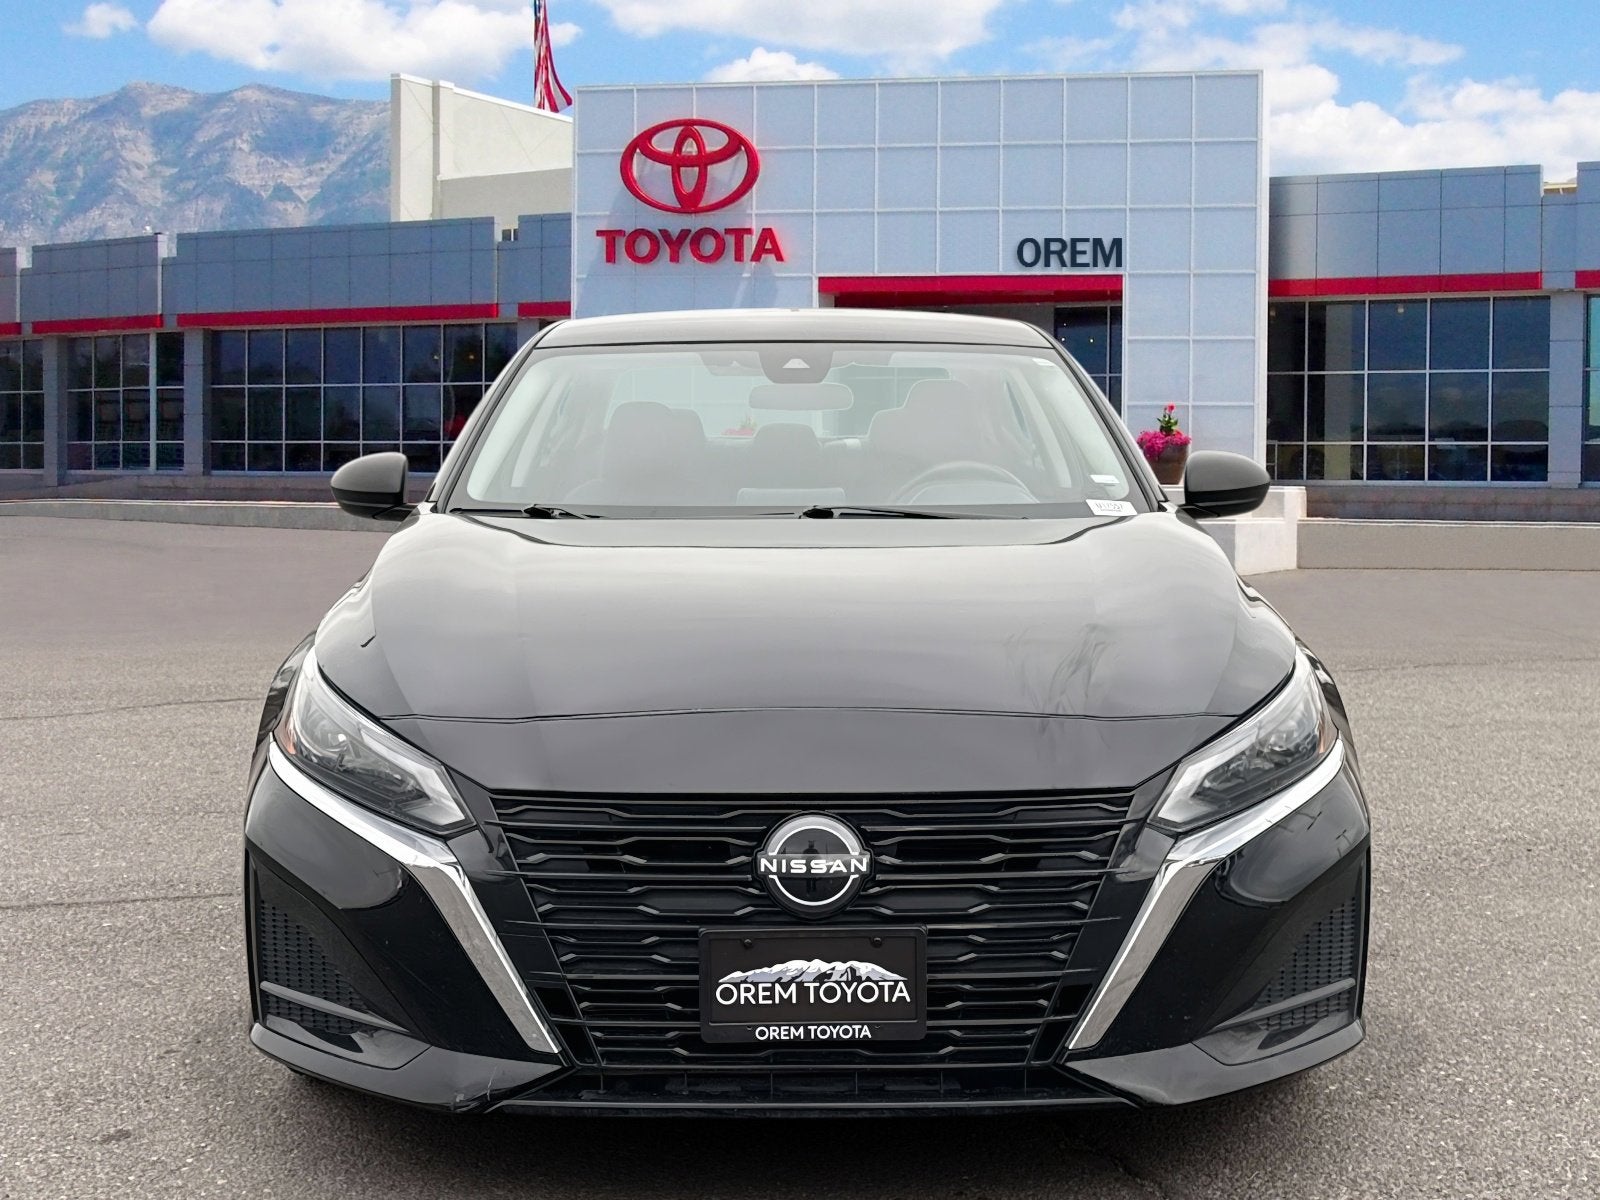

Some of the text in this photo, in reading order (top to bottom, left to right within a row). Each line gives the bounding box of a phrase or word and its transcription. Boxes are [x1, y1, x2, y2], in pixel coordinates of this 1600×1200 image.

[596, 227, 785, 264] TOYOTA
[1017, 237, 1122, 268] OREM
[760, 857, 868, 874] NISSAN
[715, 981, 911, 1005] OREM TOYOTA
[755, 1025, 872, 1040] OREM TOYOTA
